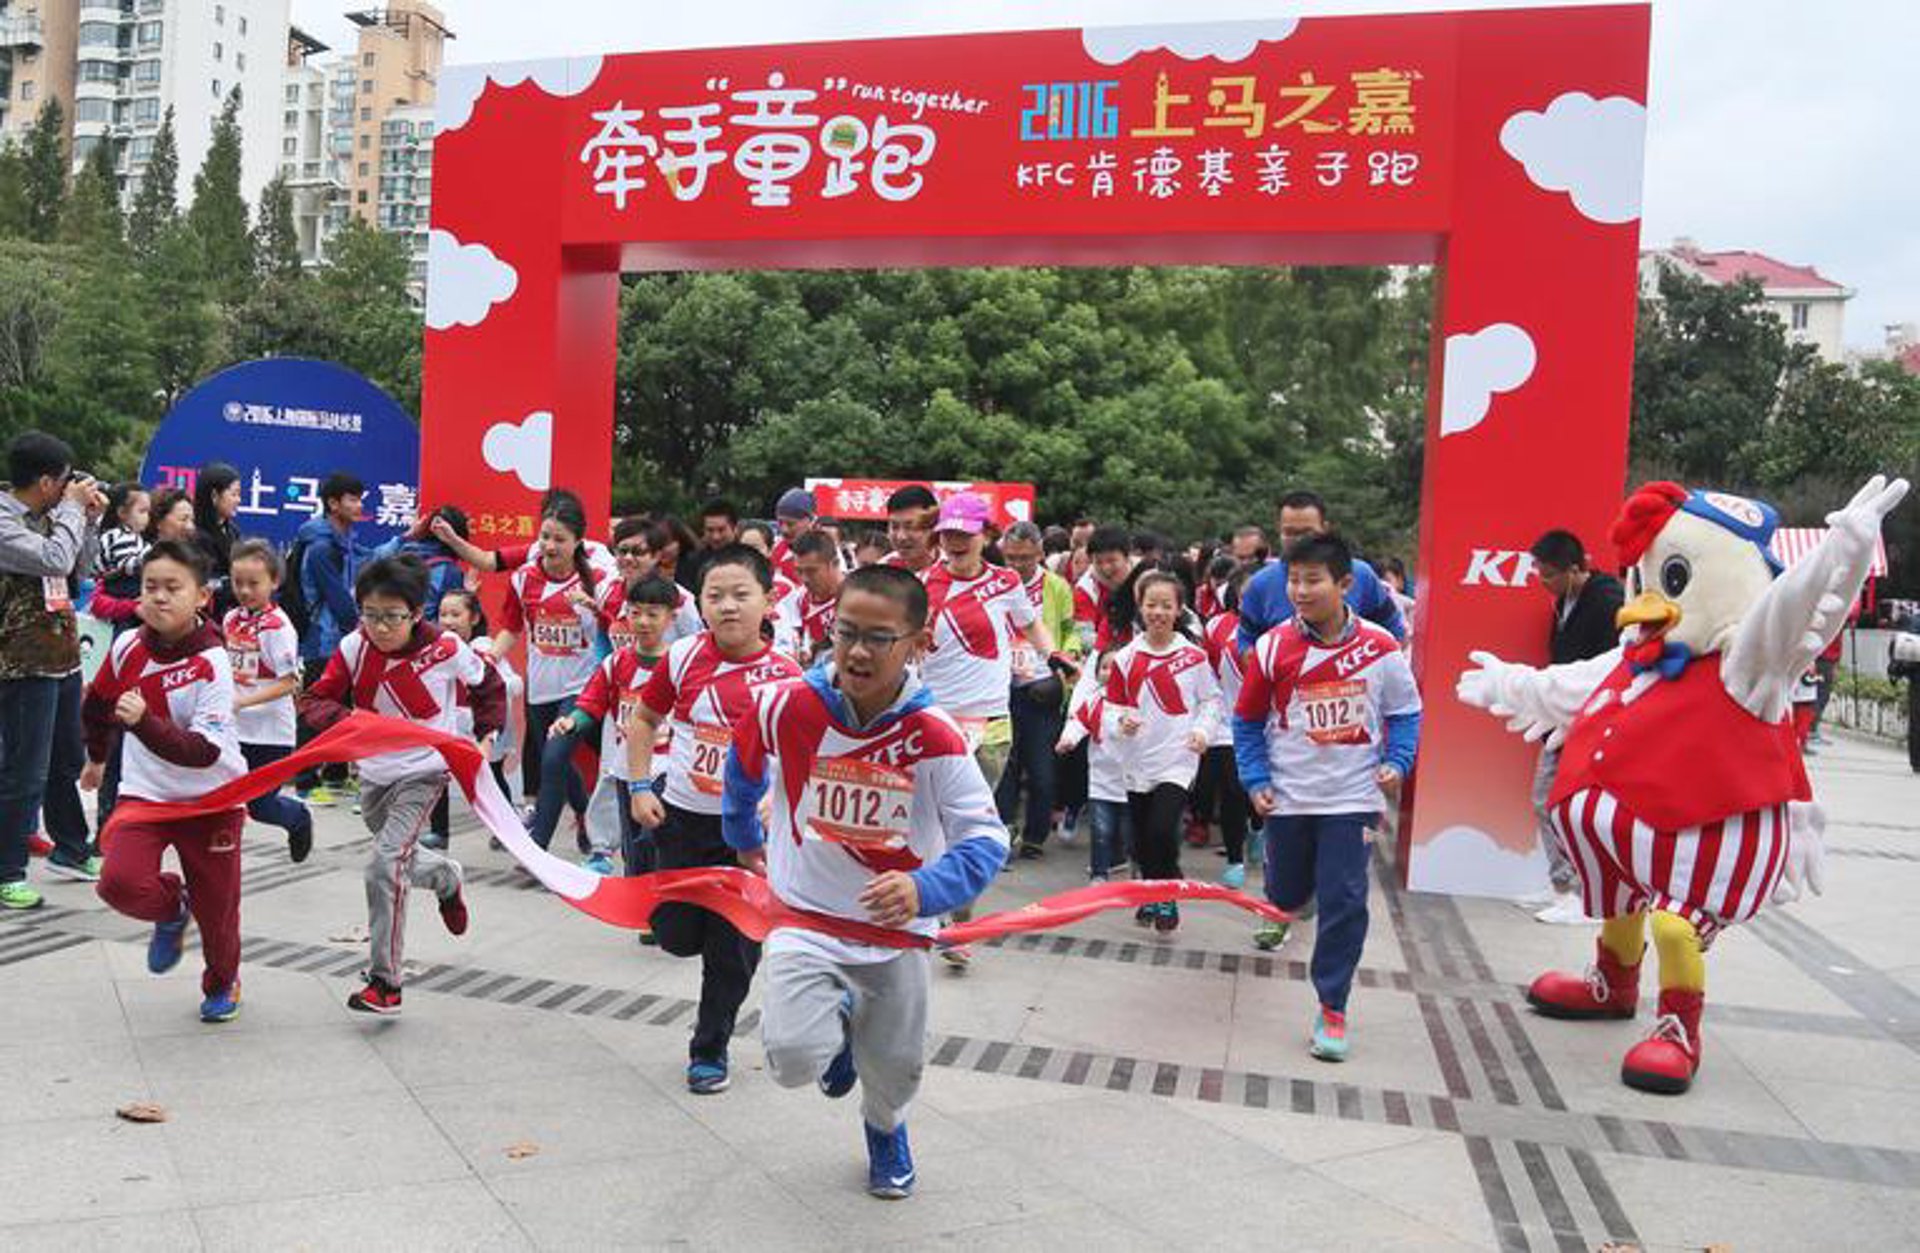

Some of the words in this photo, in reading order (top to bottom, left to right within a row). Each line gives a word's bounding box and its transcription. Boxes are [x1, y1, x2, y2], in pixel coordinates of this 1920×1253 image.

[851, 81, 885, 101] run
[891, 86, 989, 119] together
[1020, 80, 1120, 141] 2016
[1016, 163, 1076, 189] KFC
[237, 466, 419, 527] 上马嘉
[1461, 549, 1545, 587] KF
[744, 663, 786, 684] KFC
[1335, 638, 1380, 677] KFC
[161, 666, 197, 688] KFC
[1305, 699, 1350, 728] 1012
[692, 744, 727, 775] 20
[816, 782, 881, 826] 1012
[891, 804, 908, 819] A
